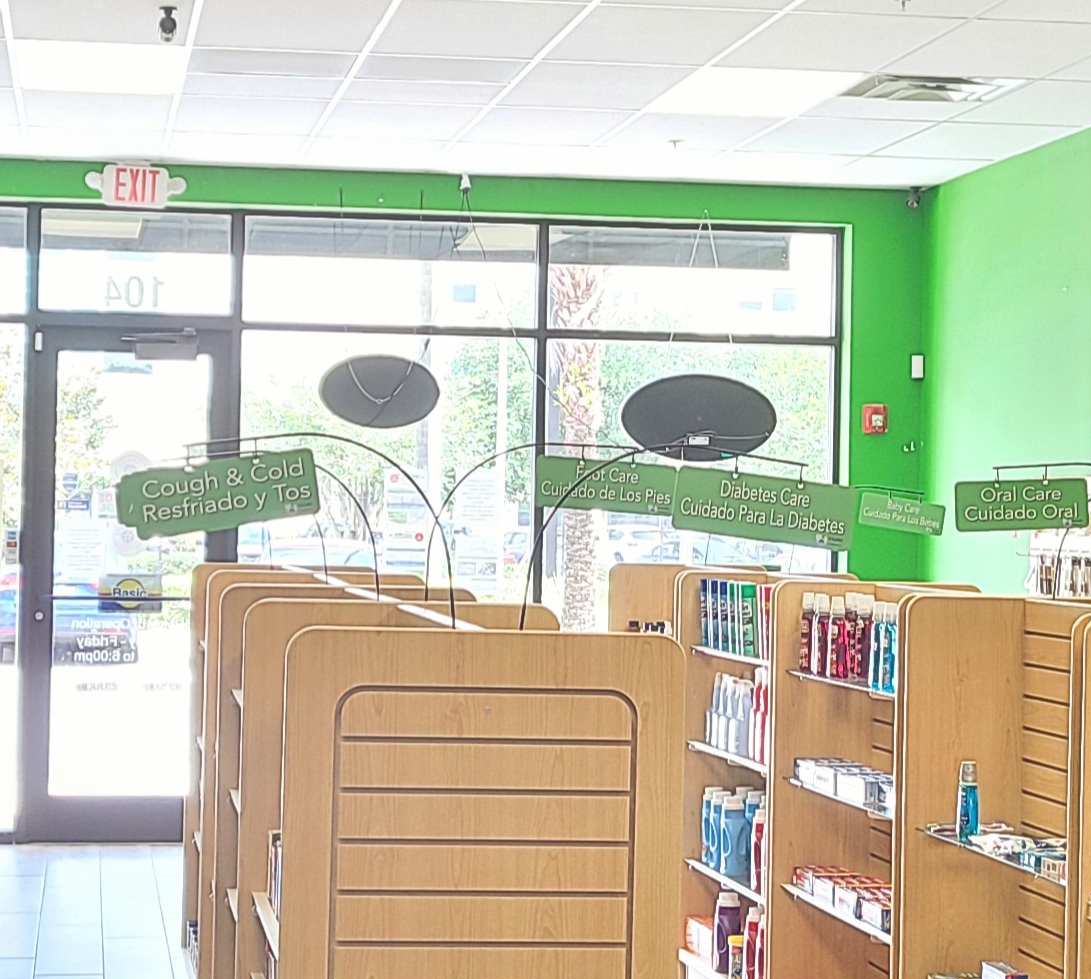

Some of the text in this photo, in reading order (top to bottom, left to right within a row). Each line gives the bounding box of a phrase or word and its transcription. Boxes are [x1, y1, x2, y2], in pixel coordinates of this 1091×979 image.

[114, 168, 160, 203] EXIT
[142, 457, 305, 498] Cough & Cold
[609, 468, 639, 484] Care
[142, 483, 311, 523] Resfriado y Tos
[541, 480, 671, 505] Cuidado de Los Pies
[720, 480, 810, 508] Diabetes Care
[980, 486, 1061, 502] Oral Care
[680, 497, 845, 535] Cuidado Para La Diabetes
[904, 503, 920, 514] Care
[965, 502, 1078, 521] Cuidado Oral
